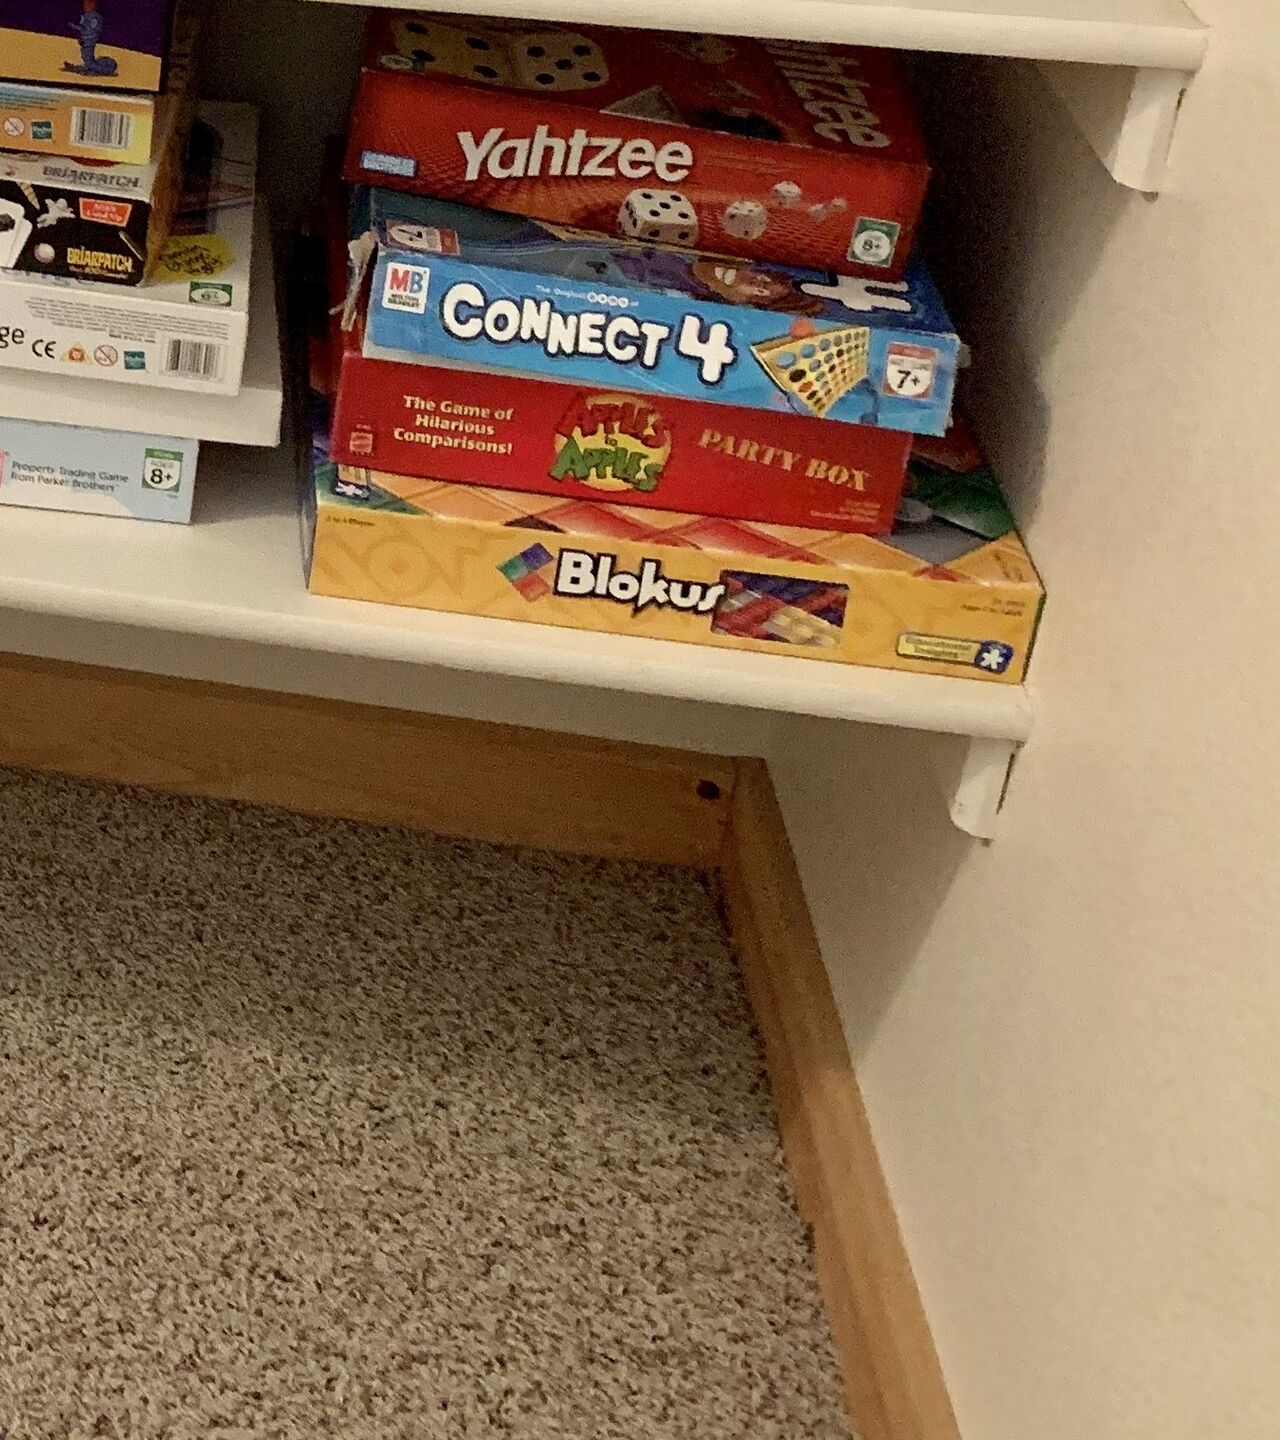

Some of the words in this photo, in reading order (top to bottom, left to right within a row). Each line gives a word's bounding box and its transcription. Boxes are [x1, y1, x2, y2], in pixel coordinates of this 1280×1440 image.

[457, 125, 693, 182] Yahtzee
[67, 246, 133, 272] BRIARPATCH
[389, 268, 425, 295] MB
[442, 281, 670, 368] CONNECT
[677, 315, 737, 384] 4
[894, 369, 922, 391] 7+
[403, 394, 436, 412] The
[441, 400, 491, 419] Game
[494, 406, 514, 421] of
[415, 414, 496, 436] Hilarious
[393, 427, 514, 456] Comparisons!
[548, 435, 663, 492] APPLES
[698, 429, 802, 472] PARTY
[806, 458, 874, 493] BOX
[150, 468, 173, 484] 8+
[557, 550, 726, 611] Blokus
